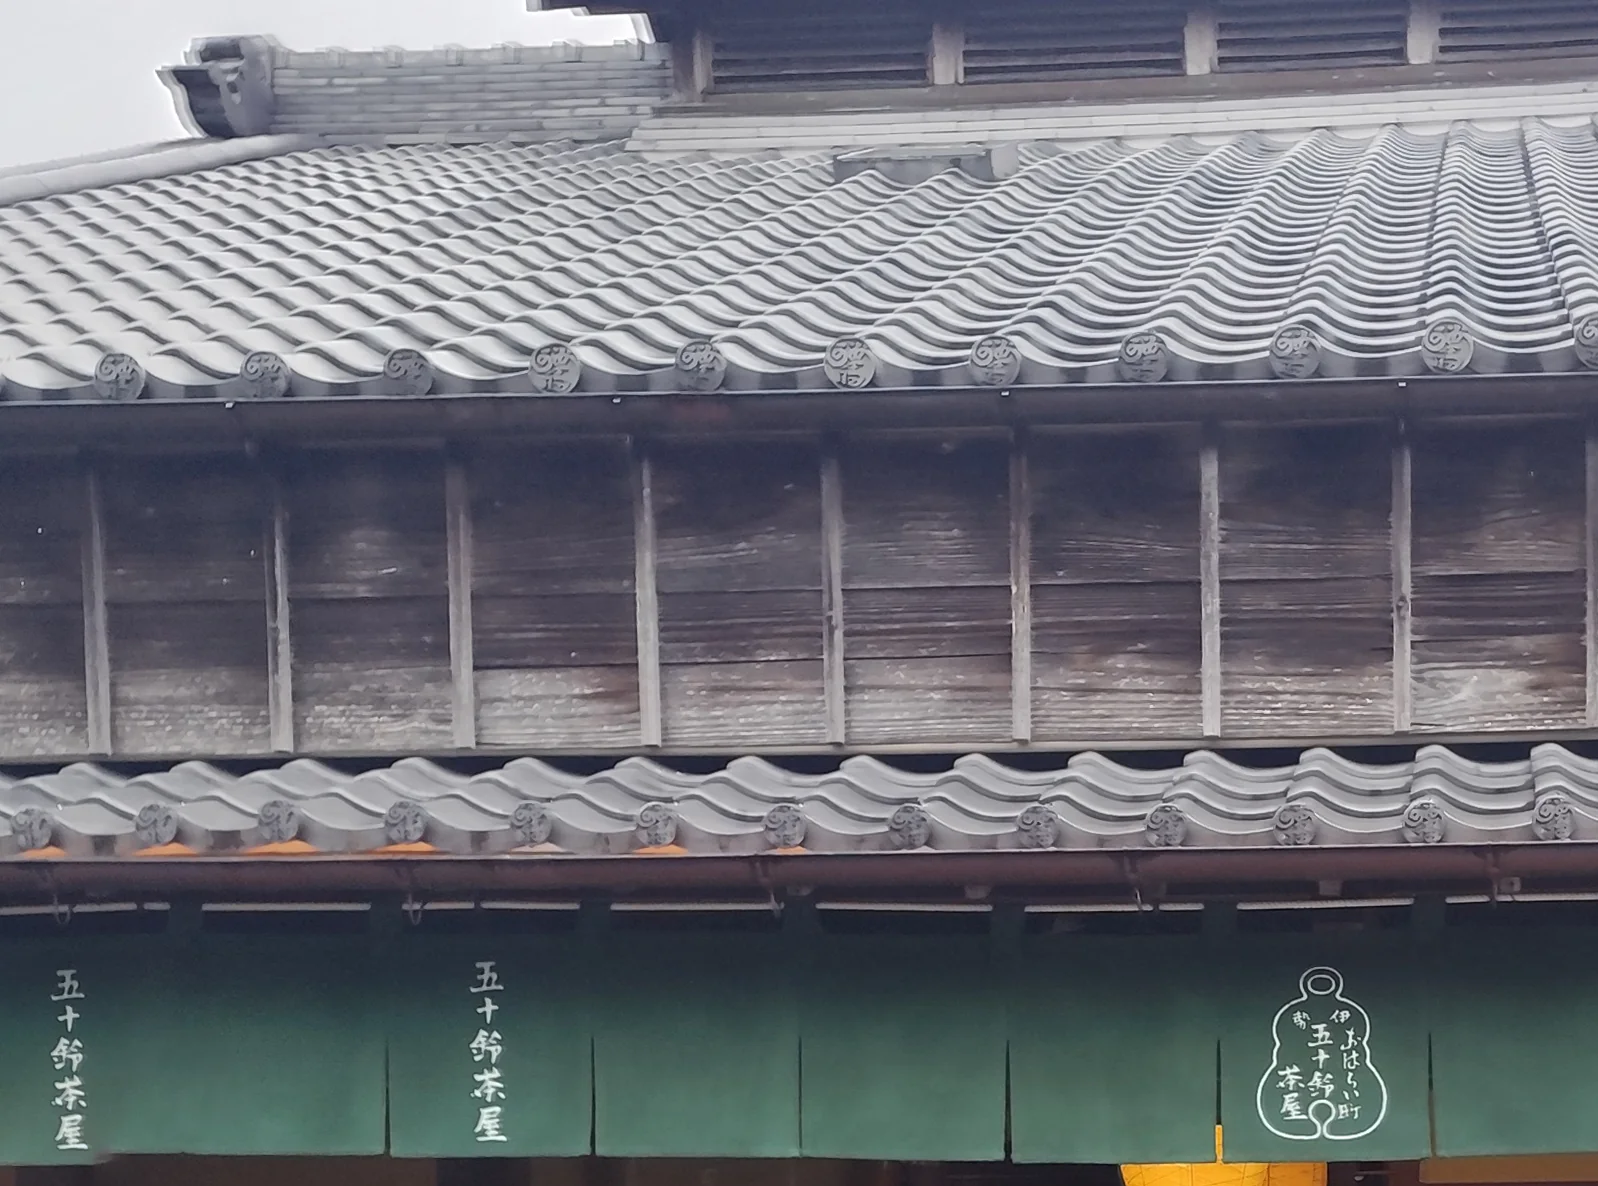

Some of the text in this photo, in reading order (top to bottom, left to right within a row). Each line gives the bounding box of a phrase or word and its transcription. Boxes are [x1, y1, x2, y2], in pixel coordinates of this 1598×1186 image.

[50, 969, 89, 1150] 五十鈴茶屋
[469, 961, 507, 1142] 五十鈴茶屋
[1338, 1026, 1362, 1119] おはらい町
